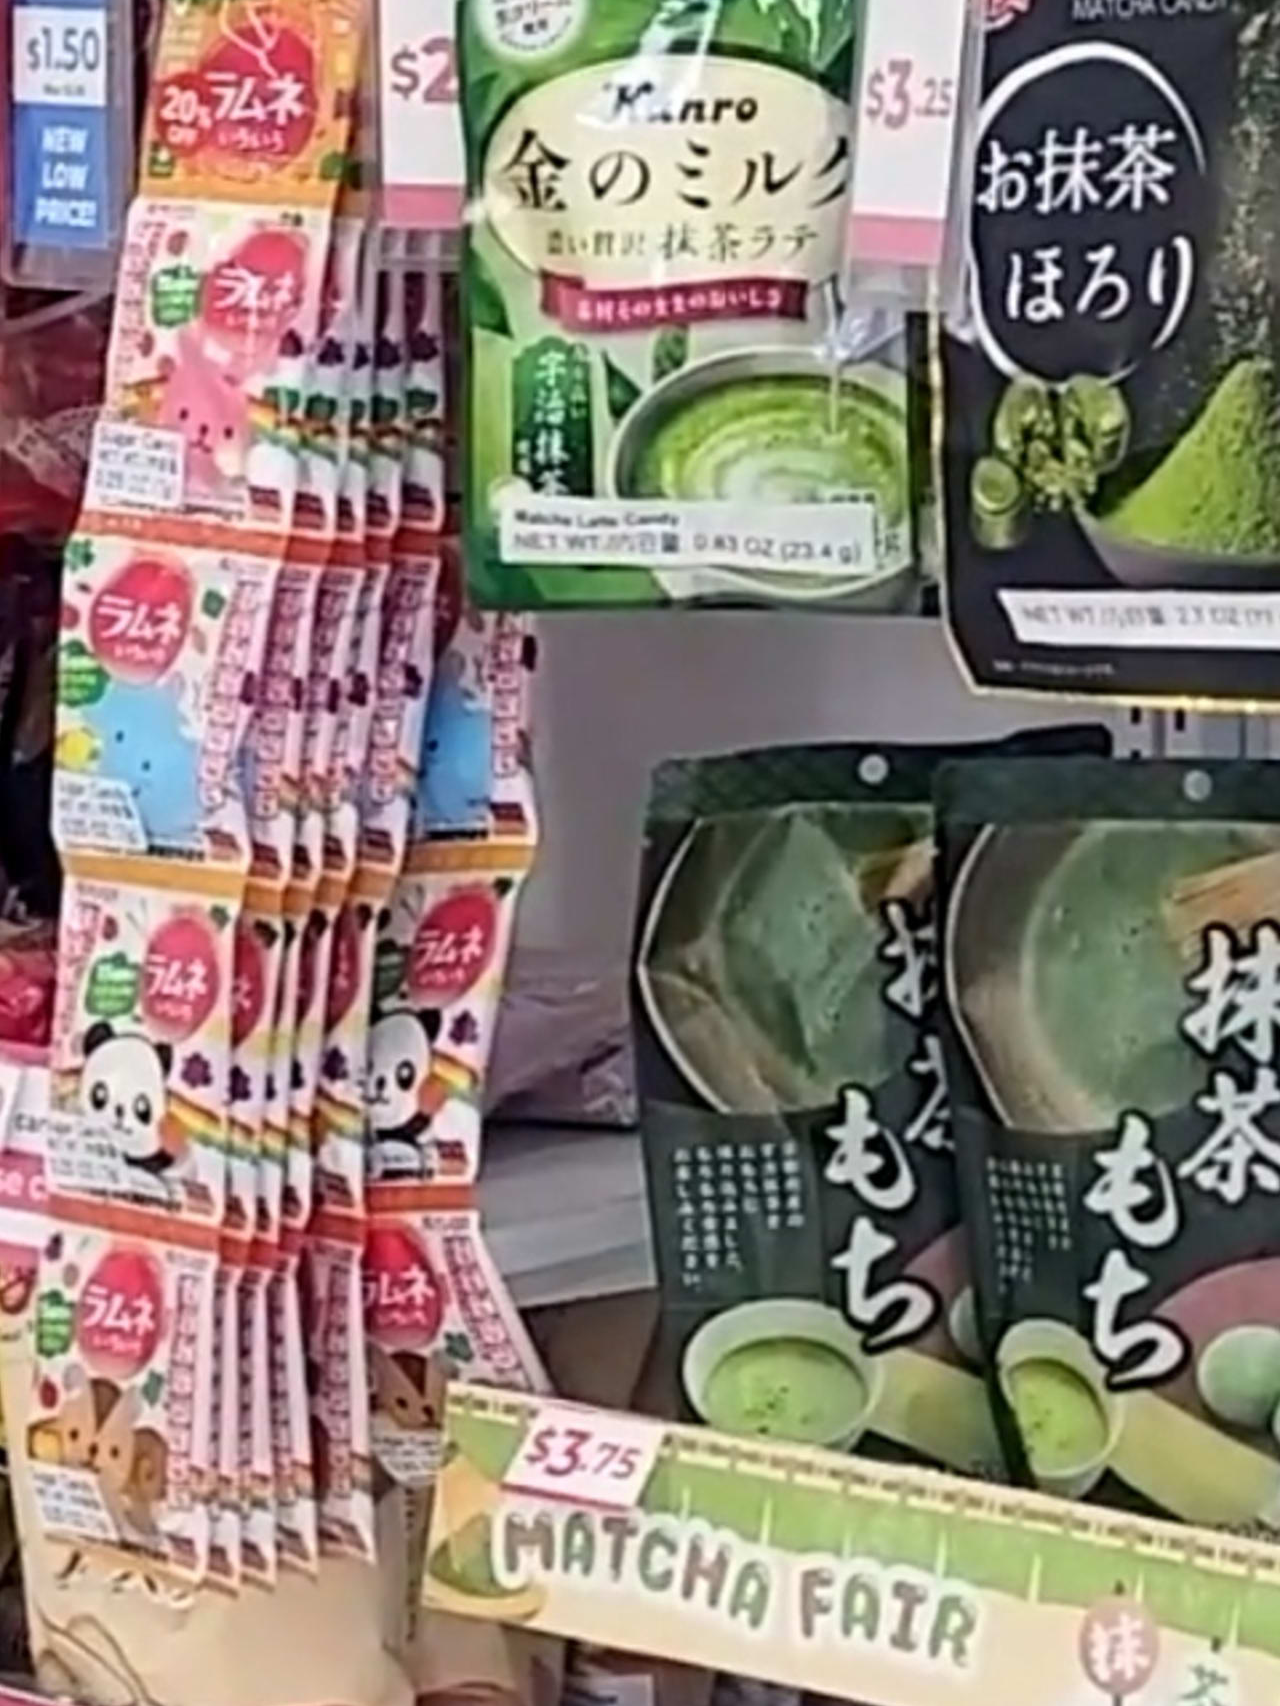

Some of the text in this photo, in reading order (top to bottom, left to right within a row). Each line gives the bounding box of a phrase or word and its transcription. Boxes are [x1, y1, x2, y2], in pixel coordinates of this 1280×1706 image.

[26, 27, 102, 74] $1.50
[40, 125, 88, 155] NEW
[866, 60, 953, 141] $3.25
[40, 163, 88, 191] LOW
[977, 124, 1176, 213] お抹茶
[1006, 235, 1195, 322] ほろり
[825, 1093, 939, 1348] もち
[1084, 1114, 1186, 1387] もち
[524, 1426, 642, 1479] $3.75
[501, 1510, 979, 1667] MATCHA FAIR
